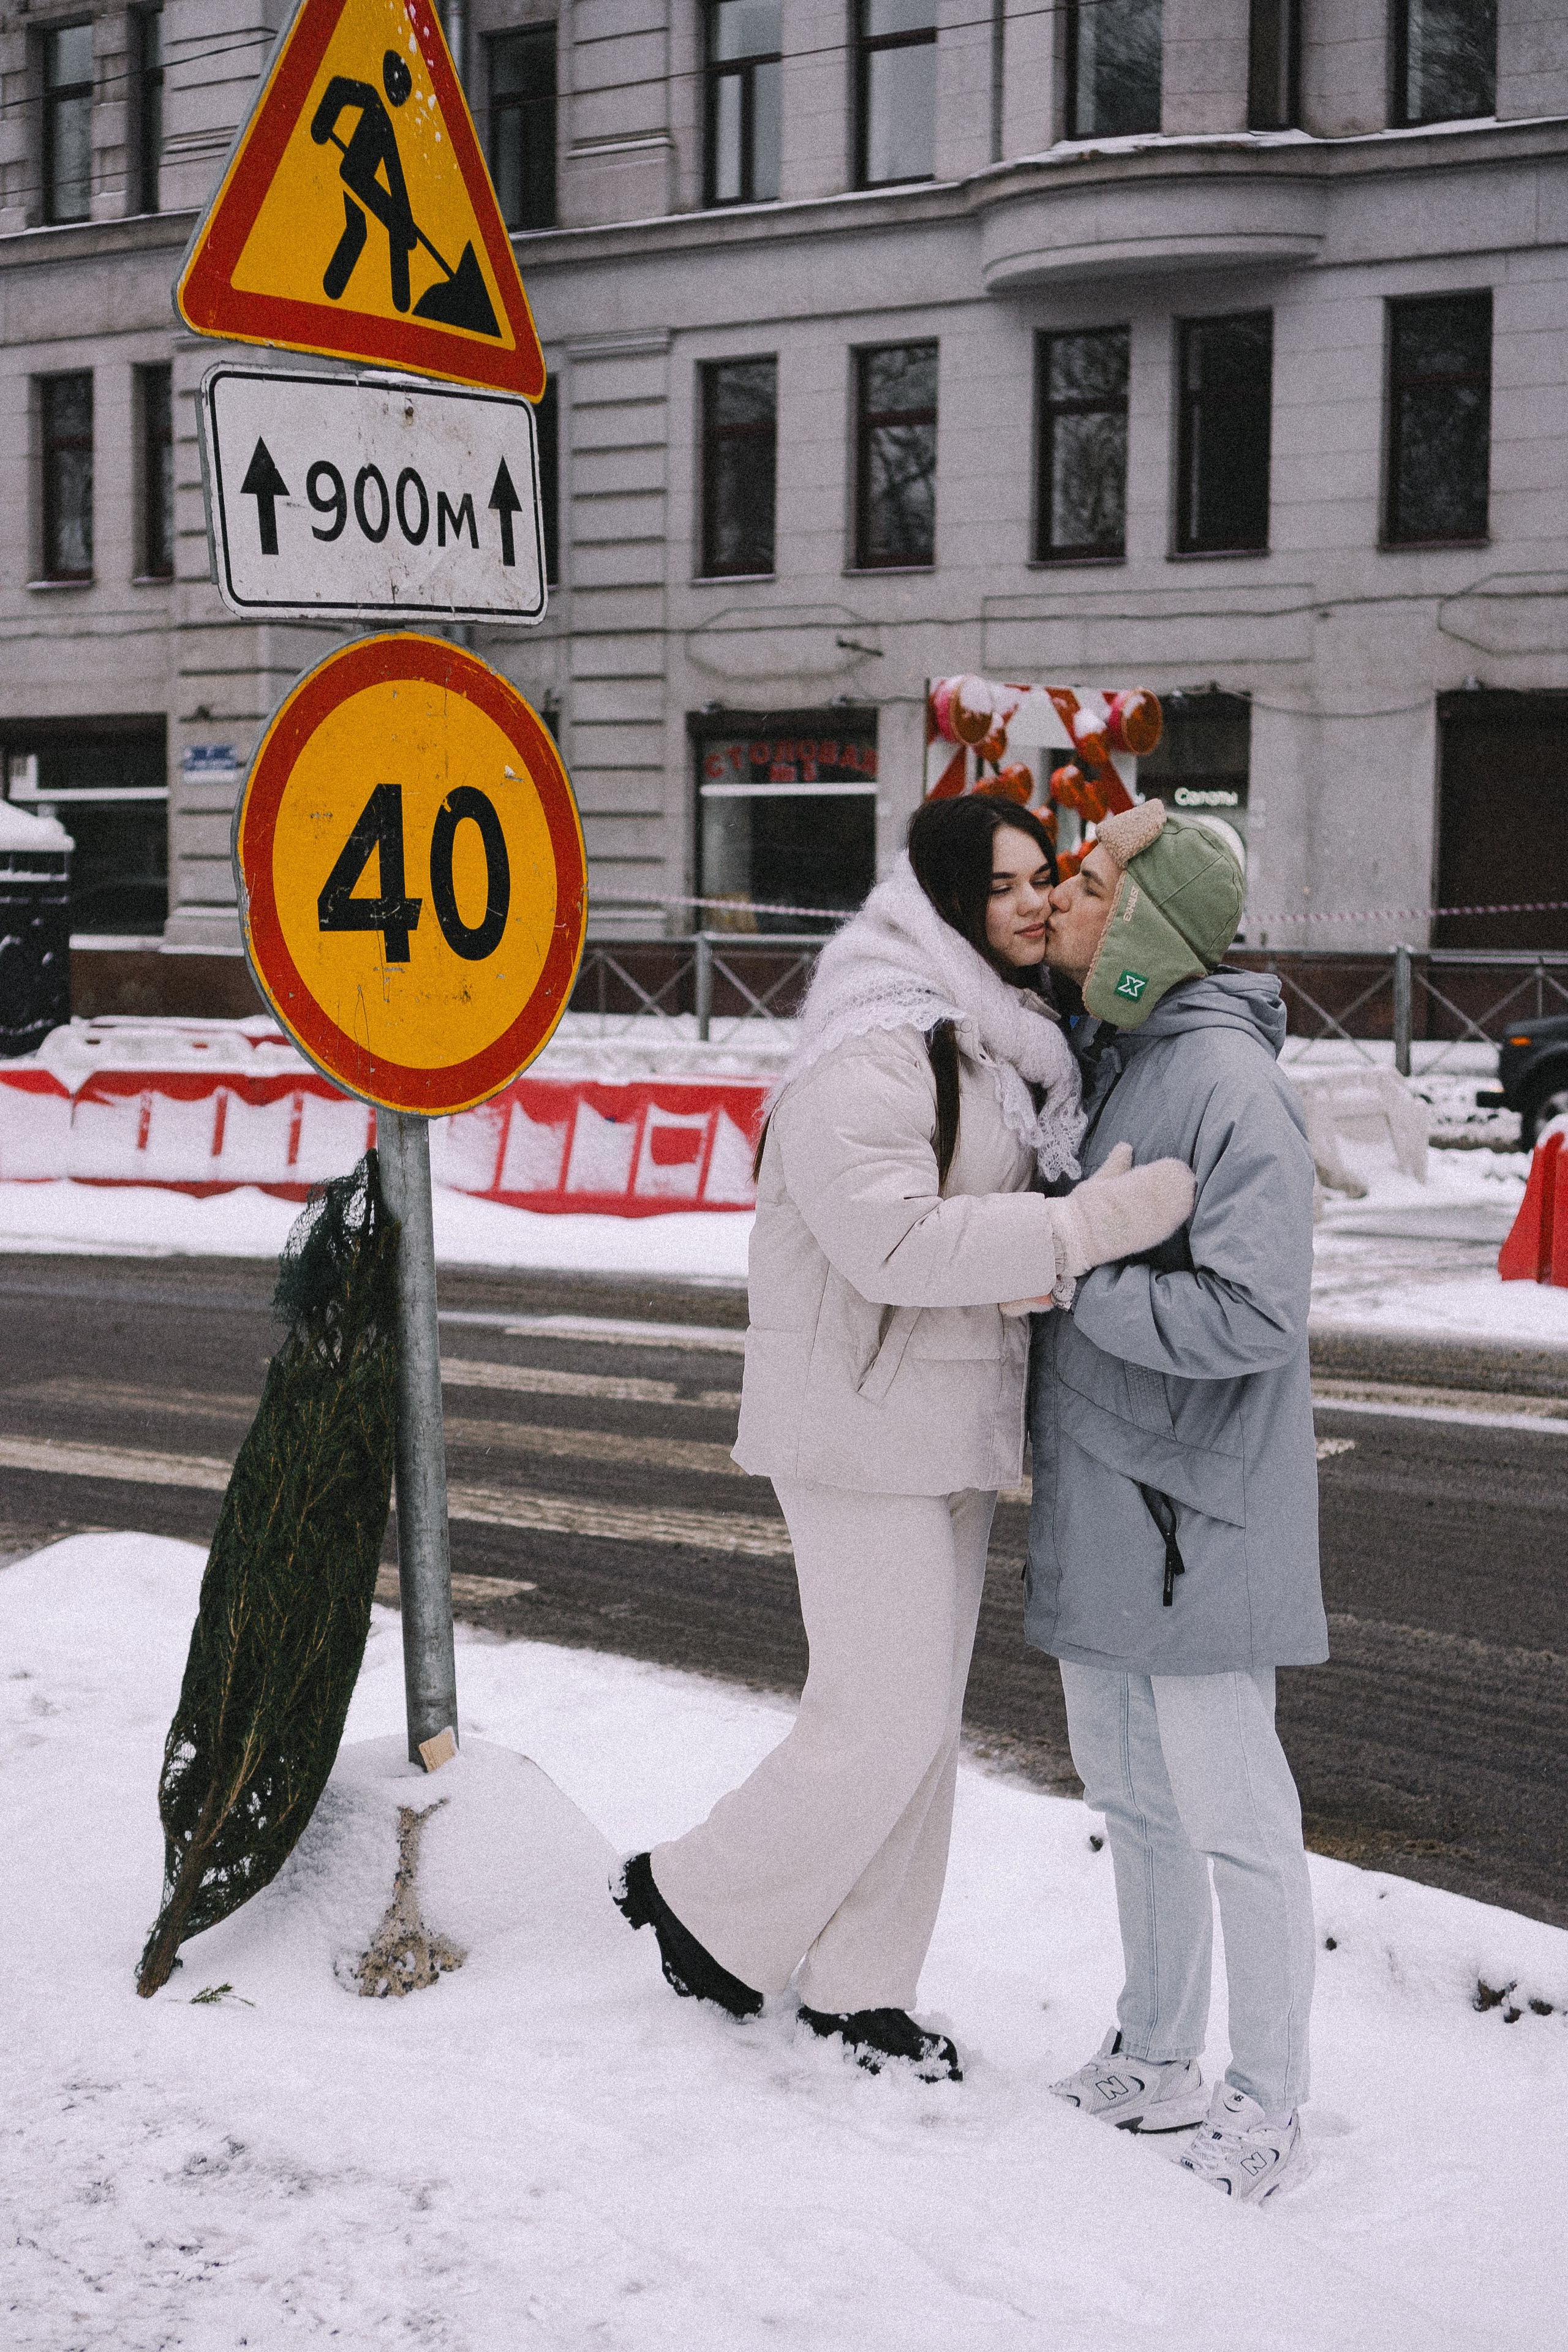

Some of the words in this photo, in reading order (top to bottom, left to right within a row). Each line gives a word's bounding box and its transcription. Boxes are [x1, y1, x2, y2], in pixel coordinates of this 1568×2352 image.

[705, 739, 878, 778] СТОЛОВАЯ
[317, 783, 511, 963] 40
[1095, 2075, 1129, 2100] N
[1240, 2151, 1267, 2176] N
